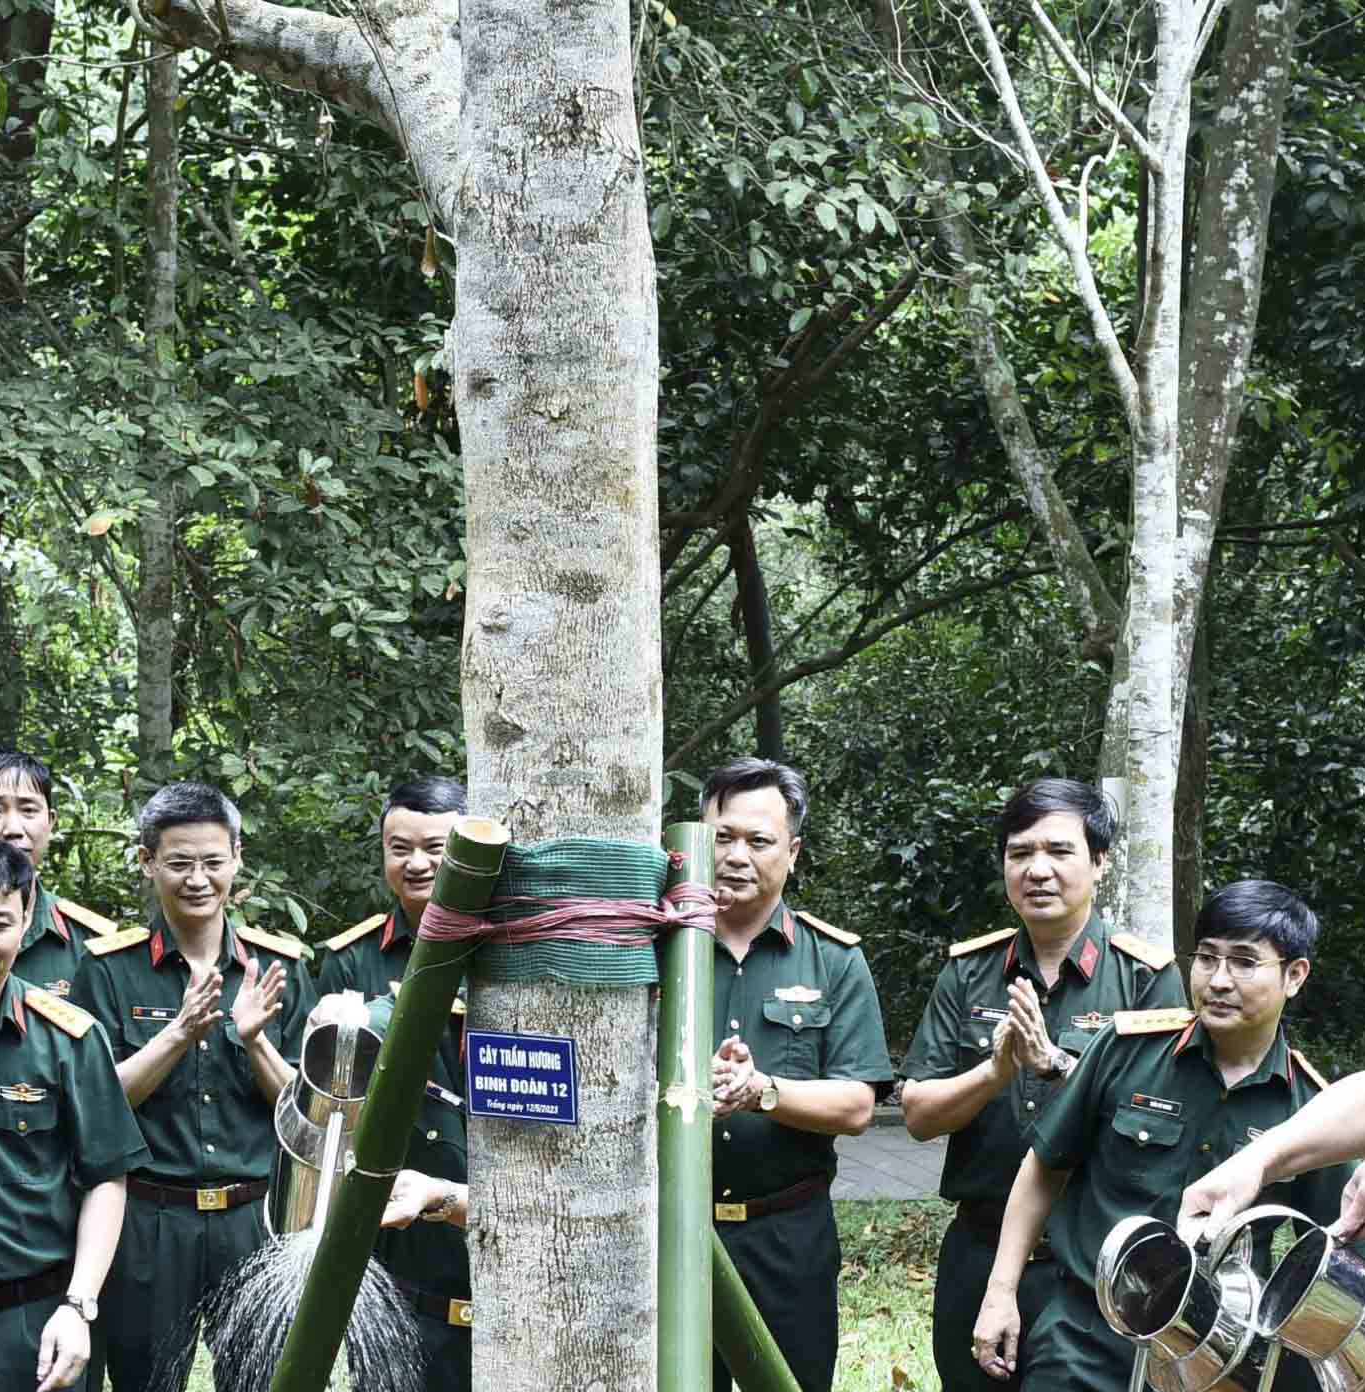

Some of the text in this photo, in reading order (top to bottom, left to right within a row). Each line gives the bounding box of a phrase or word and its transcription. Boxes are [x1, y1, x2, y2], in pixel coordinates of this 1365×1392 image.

[479, 1044, 498, 1065] CÂY
[475, 1075, 568, 1098] BINH ĐOÀN 12
